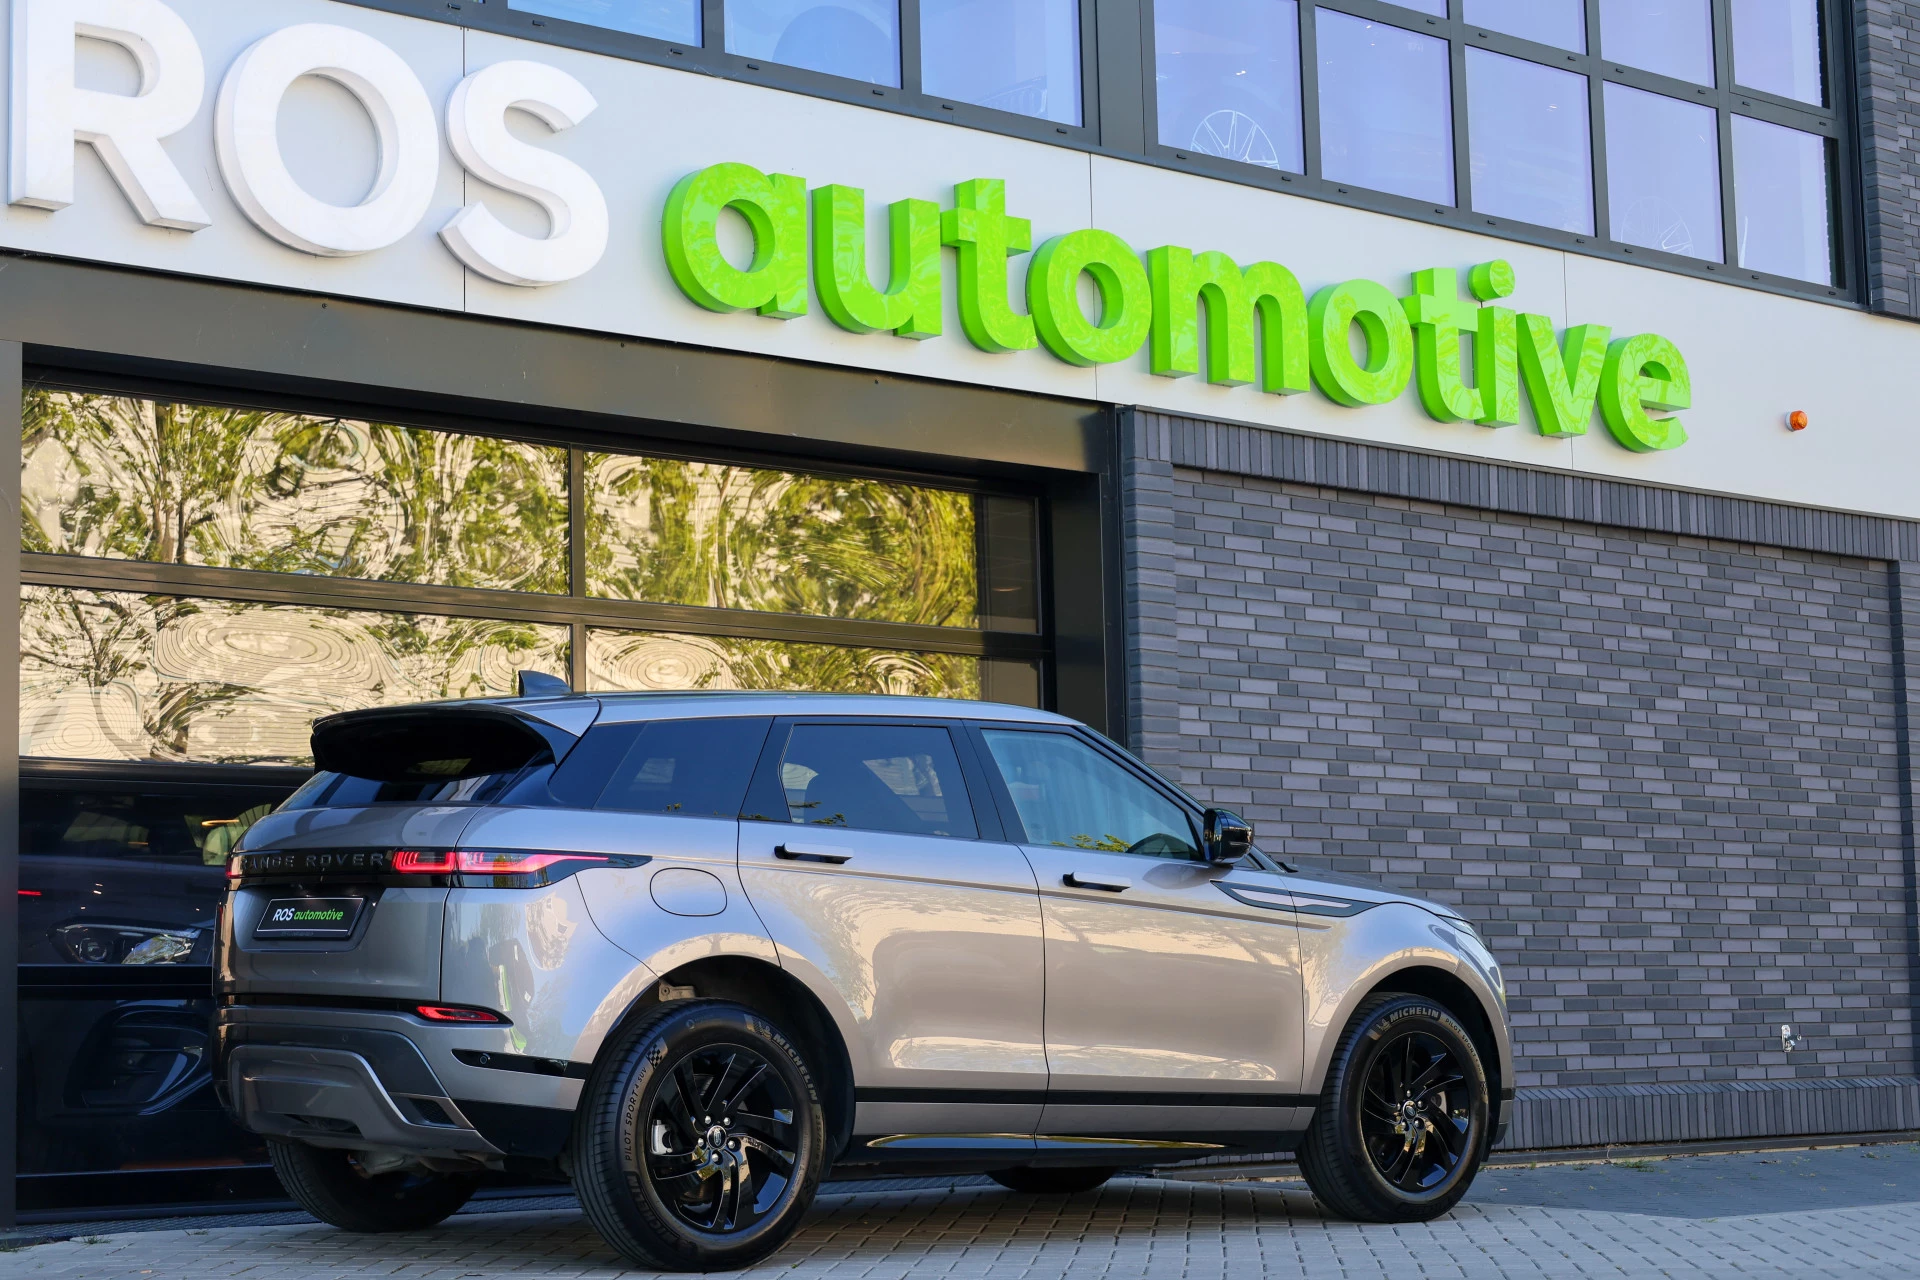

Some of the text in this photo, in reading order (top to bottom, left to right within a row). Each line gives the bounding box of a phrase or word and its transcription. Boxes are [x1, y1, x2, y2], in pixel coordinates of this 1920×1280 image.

[9, 0, 1692, 455] ROS automotive
[241, 853, 384, 870] RANGE ROVER
[272, 908, 344, 921] ROS automotive
[1389, 1006, 1439, 1023] MICHELIN
[1445, 1017, 1477, 1058] PILOT SPORT
[637, 1066, 647, 1083] SUV
[773, 1033, 818, 1101] MICHELIN
[625, 1090, 639, 1126] SPORT
[624, 1129, 633, 1161] PILOT
